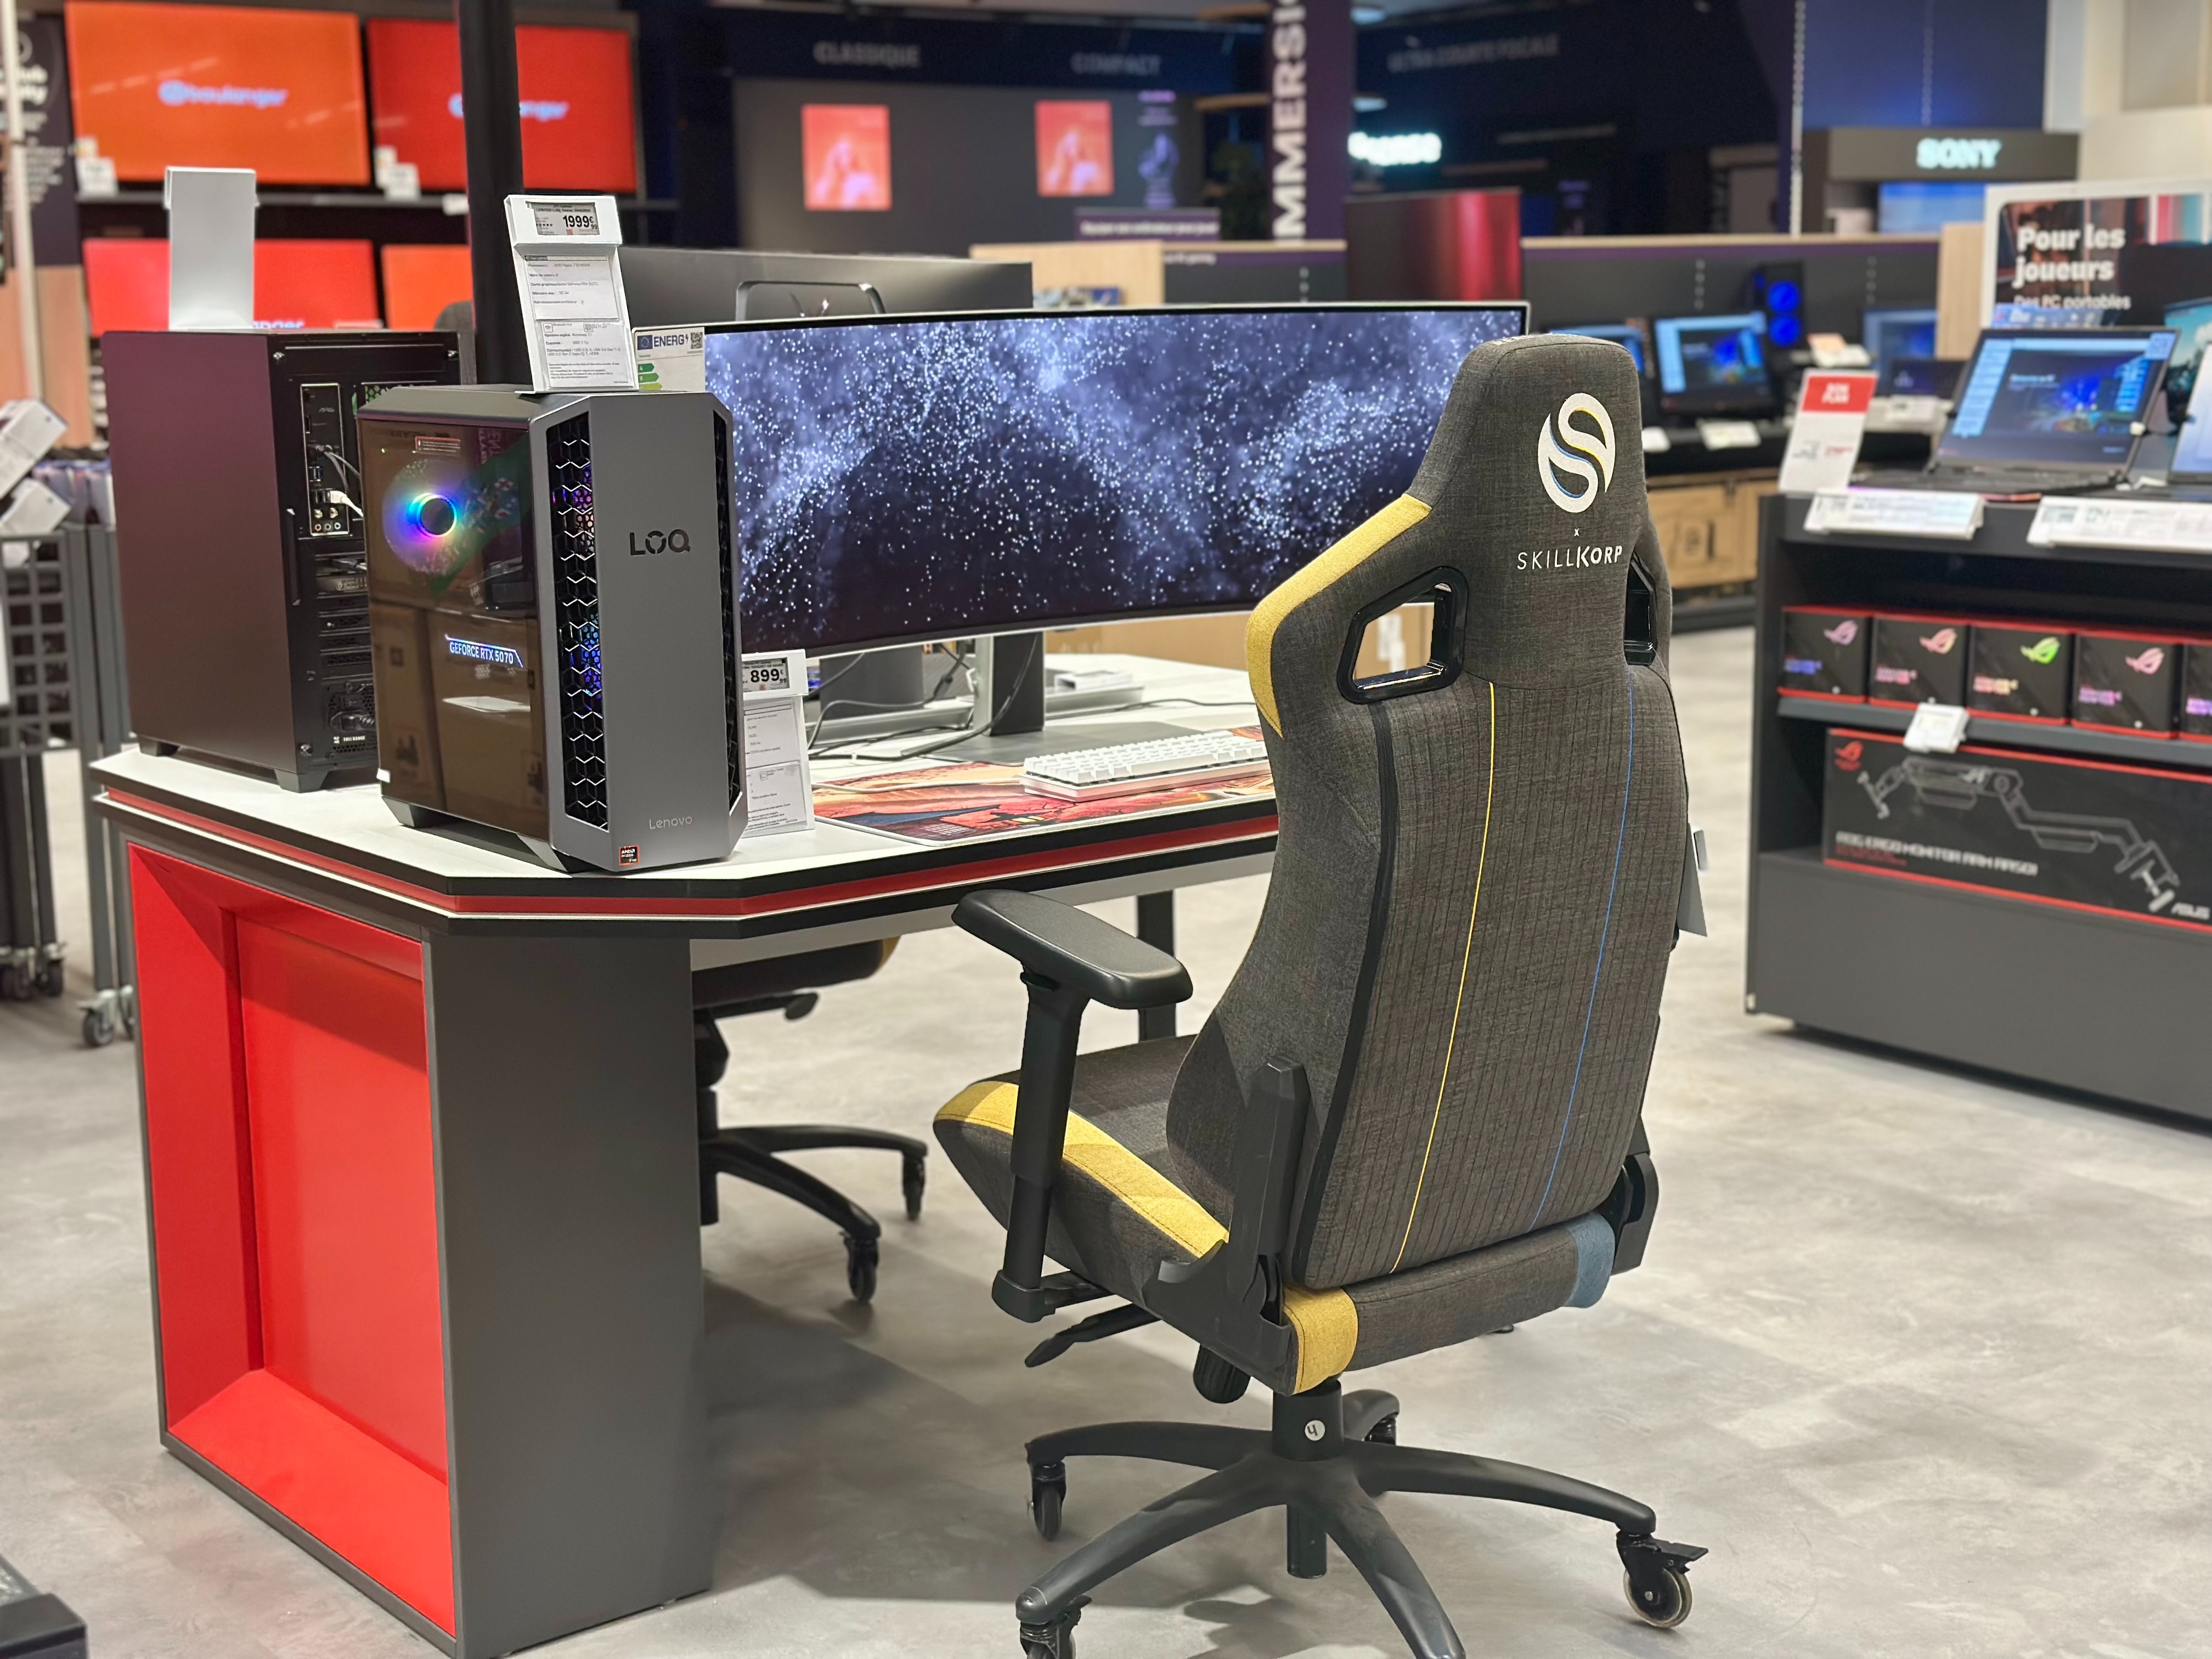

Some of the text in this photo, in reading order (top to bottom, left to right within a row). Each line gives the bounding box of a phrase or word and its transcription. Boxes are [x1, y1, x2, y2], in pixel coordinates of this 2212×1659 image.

[1273, 0, 1307, 245] MMERSI
[1916, 138, 2002, 169] SONY
[2017, 222, 2126, 252] Pour les
[2011, 255, 2115, 289] joueurs
[654, 334, 685, 347] ENERG
[630, 529, 691, 556] LOQ
[1517, 545, 1622, 570] SKILLKORP
[449, 641, 514, 664] GEFORCE RTX 5070
[650, 816, 692, 830] Lenovo
